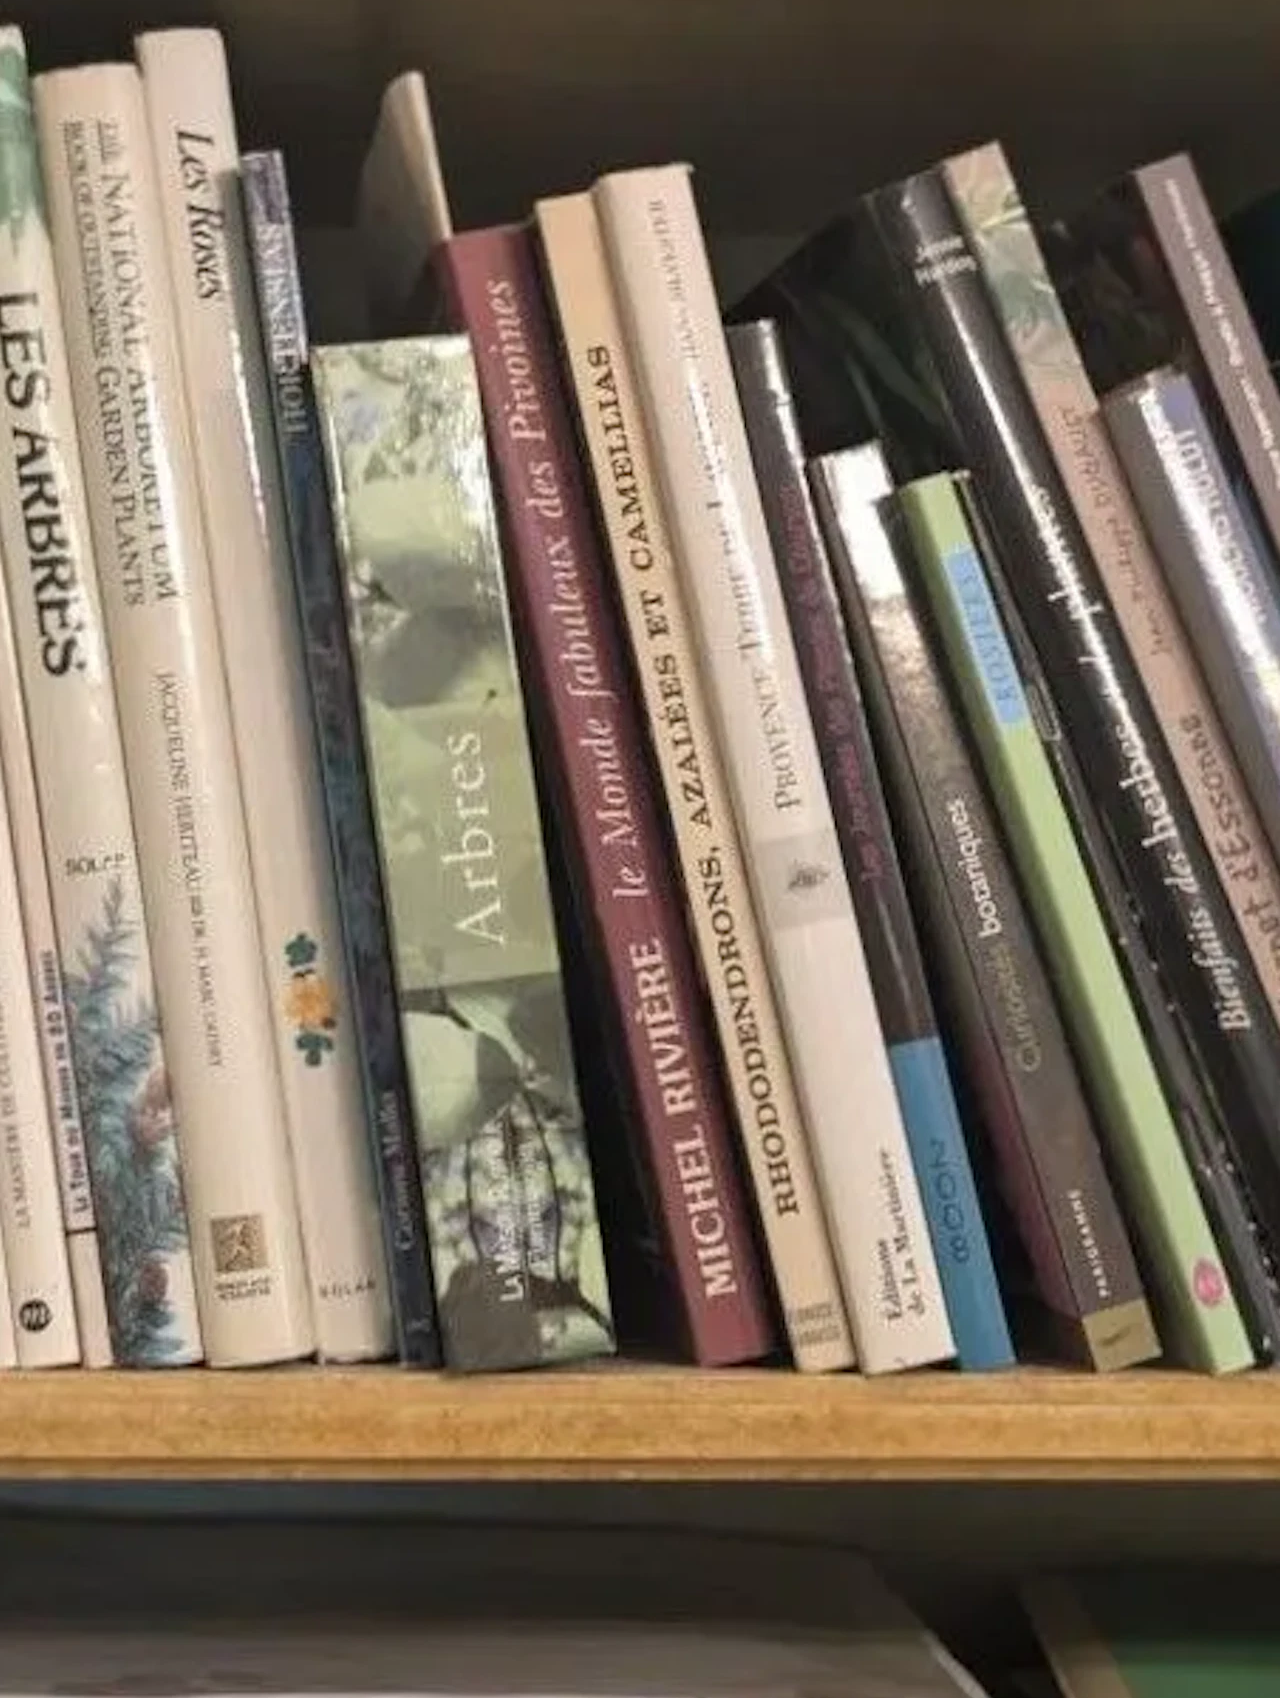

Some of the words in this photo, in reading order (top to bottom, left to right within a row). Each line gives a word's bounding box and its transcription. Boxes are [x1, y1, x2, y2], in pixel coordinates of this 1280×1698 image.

[481, 278, 548, 442] Pivoines
[11, 426, 87, 677] ARBRES
[525, 459, 564, 520] des
[542, 536, 614, 699] fabuleux
[440, 731, 504, 944] Arbres
[587, 717, 641, 849] Monde
[611, 862, 651, 899] le
[629, 935, 698, 1110] RIVIÈRE
[674, 1121, 740, 1296] MICHEL
